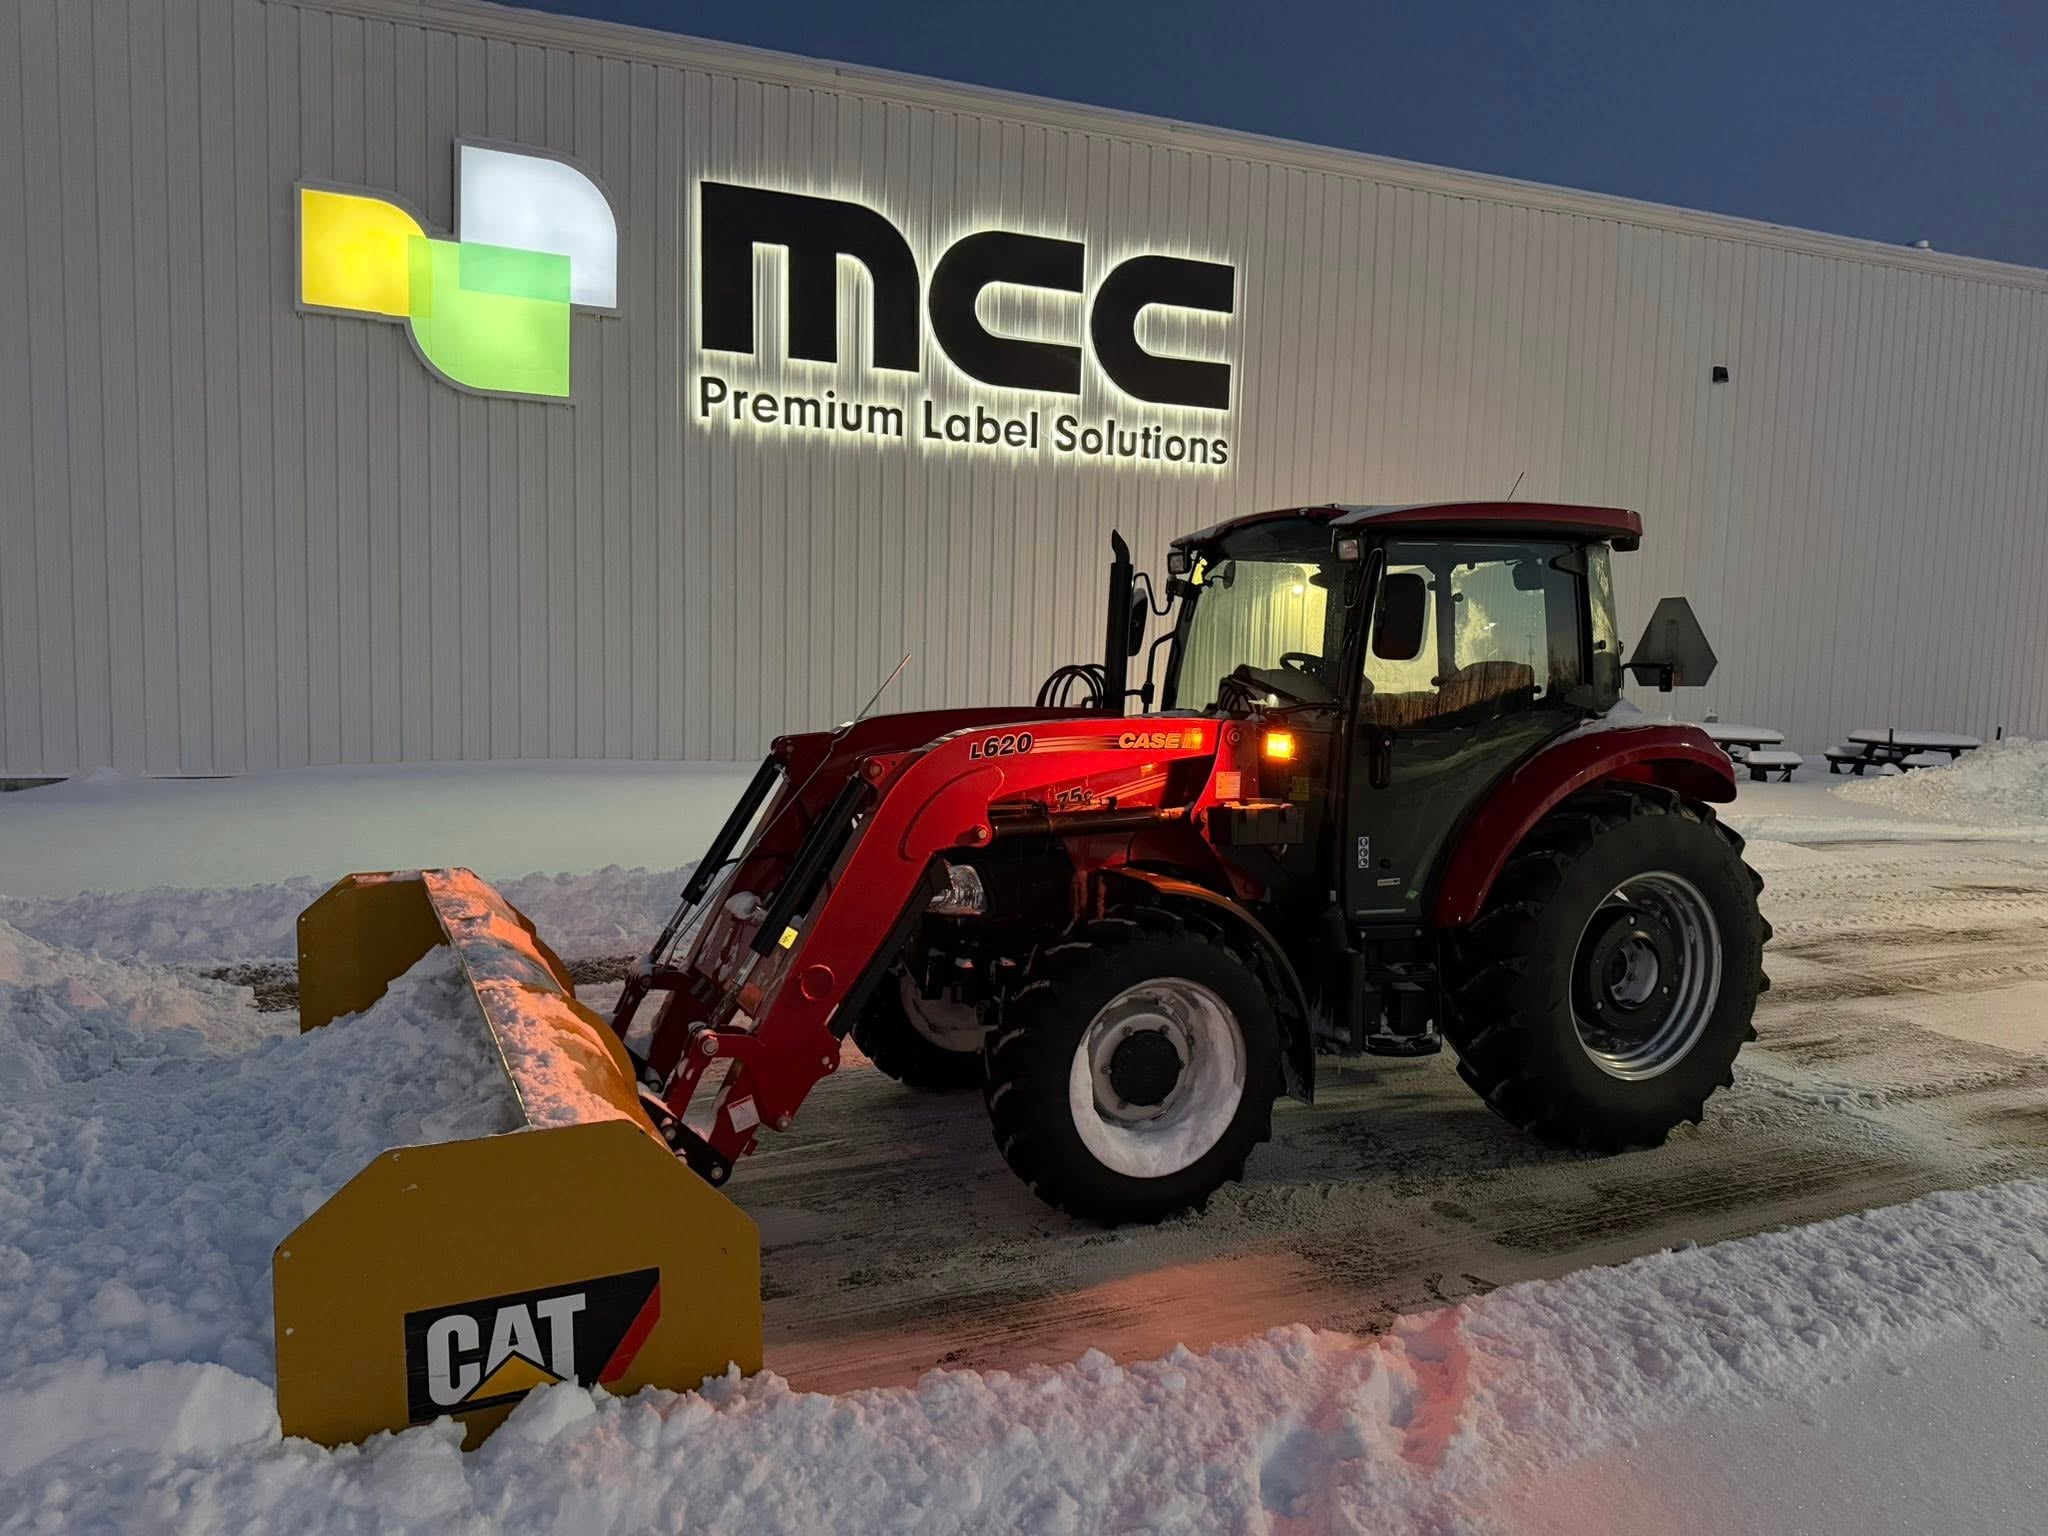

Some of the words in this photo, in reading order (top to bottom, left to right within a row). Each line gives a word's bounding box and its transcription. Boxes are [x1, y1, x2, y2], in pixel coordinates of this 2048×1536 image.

[700, 376, 902, 436] Premium
[923, 400, 1038, 448] Label
[1054, 414, 1228, 464] Solutions
[969, 732, 1032, 760] L620
[1119, 732, 1181, 749] CASE
[427, 1293, 586, 1406] CAT
